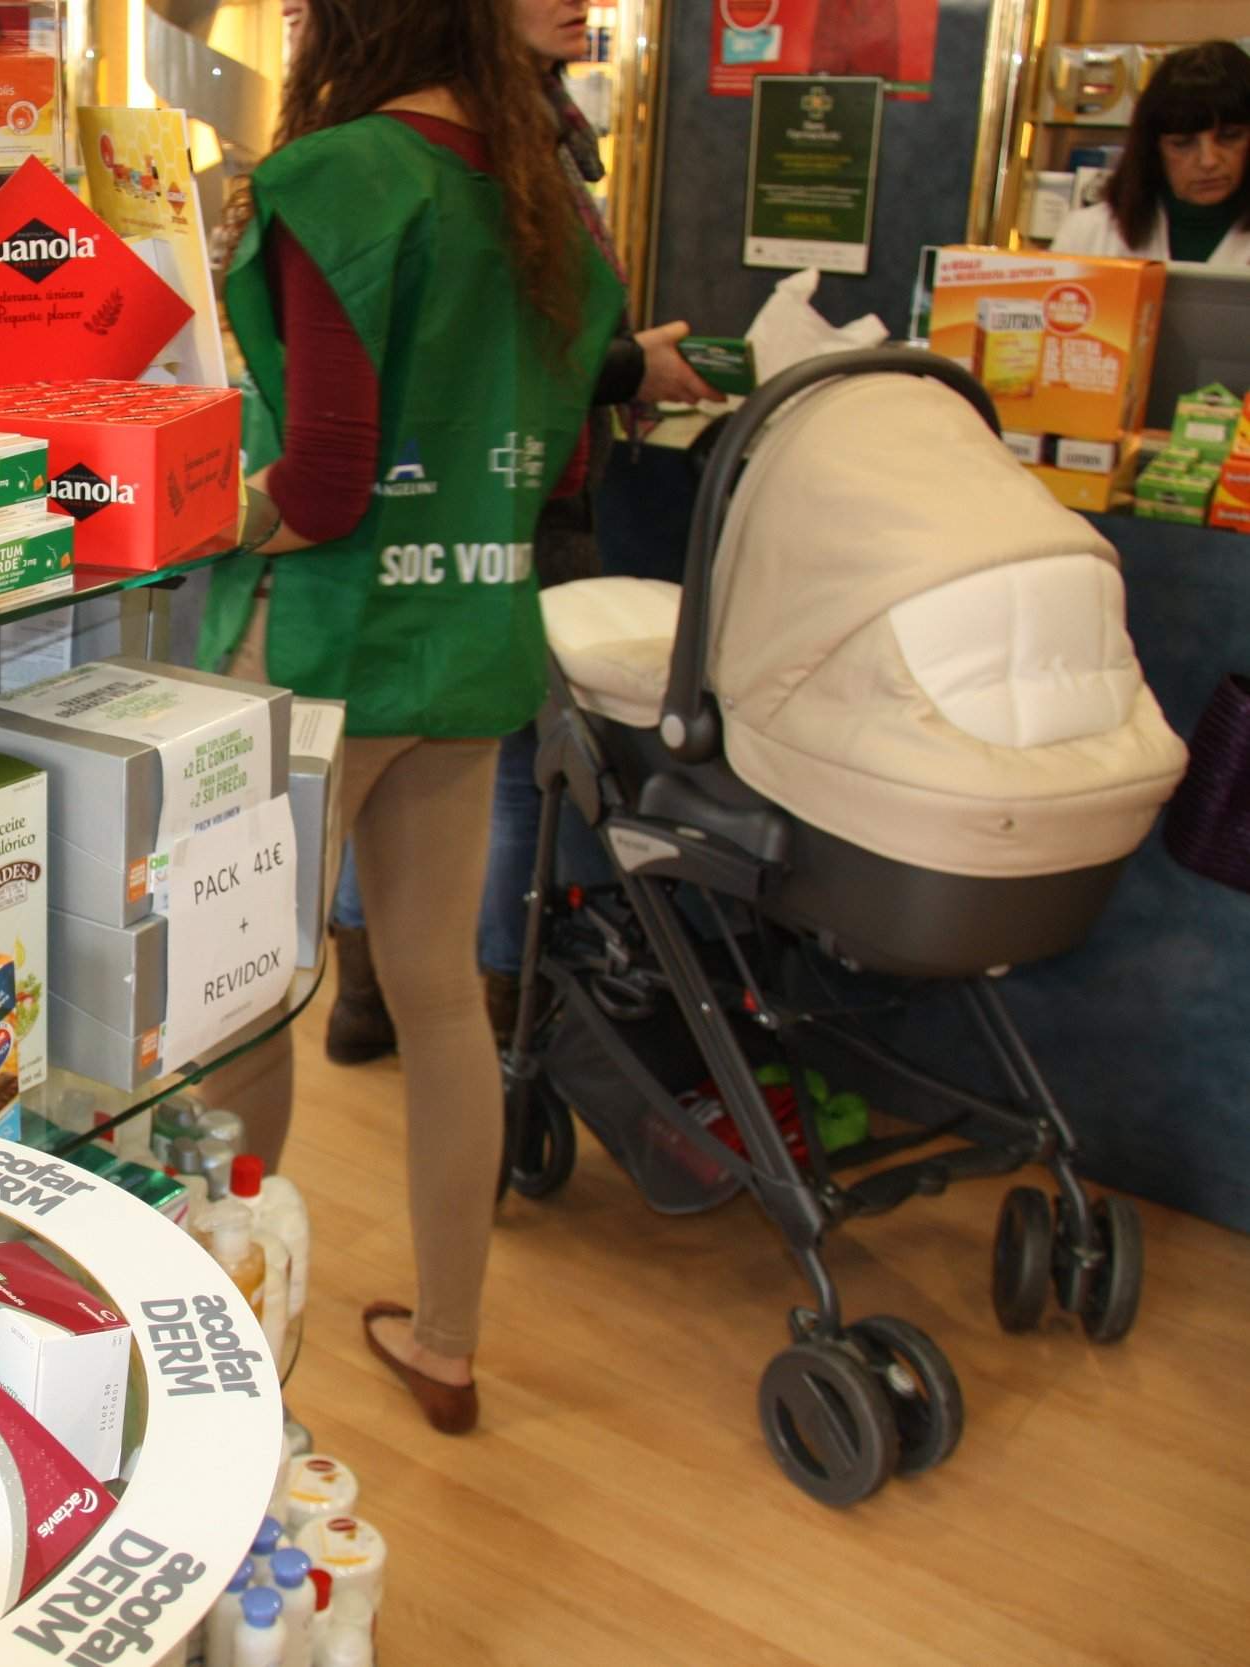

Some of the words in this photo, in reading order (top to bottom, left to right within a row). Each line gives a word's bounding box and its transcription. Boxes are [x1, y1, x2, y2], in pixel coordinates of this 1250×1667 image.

[378, 542, 446, 586] SOC
[193, 862, 241, 905] PACK
[253, 842, 284, 874] 41€
[239, 917, 249, 934] +
[203, 947, 281, 1006] REVIDOX
[140, 1298, 217, 1398] DERM
[191, 1294, 264, 1399] acofar
[36, 1491, 84, 1539] actavis
[11, 1527, 170, 1657] DERM
